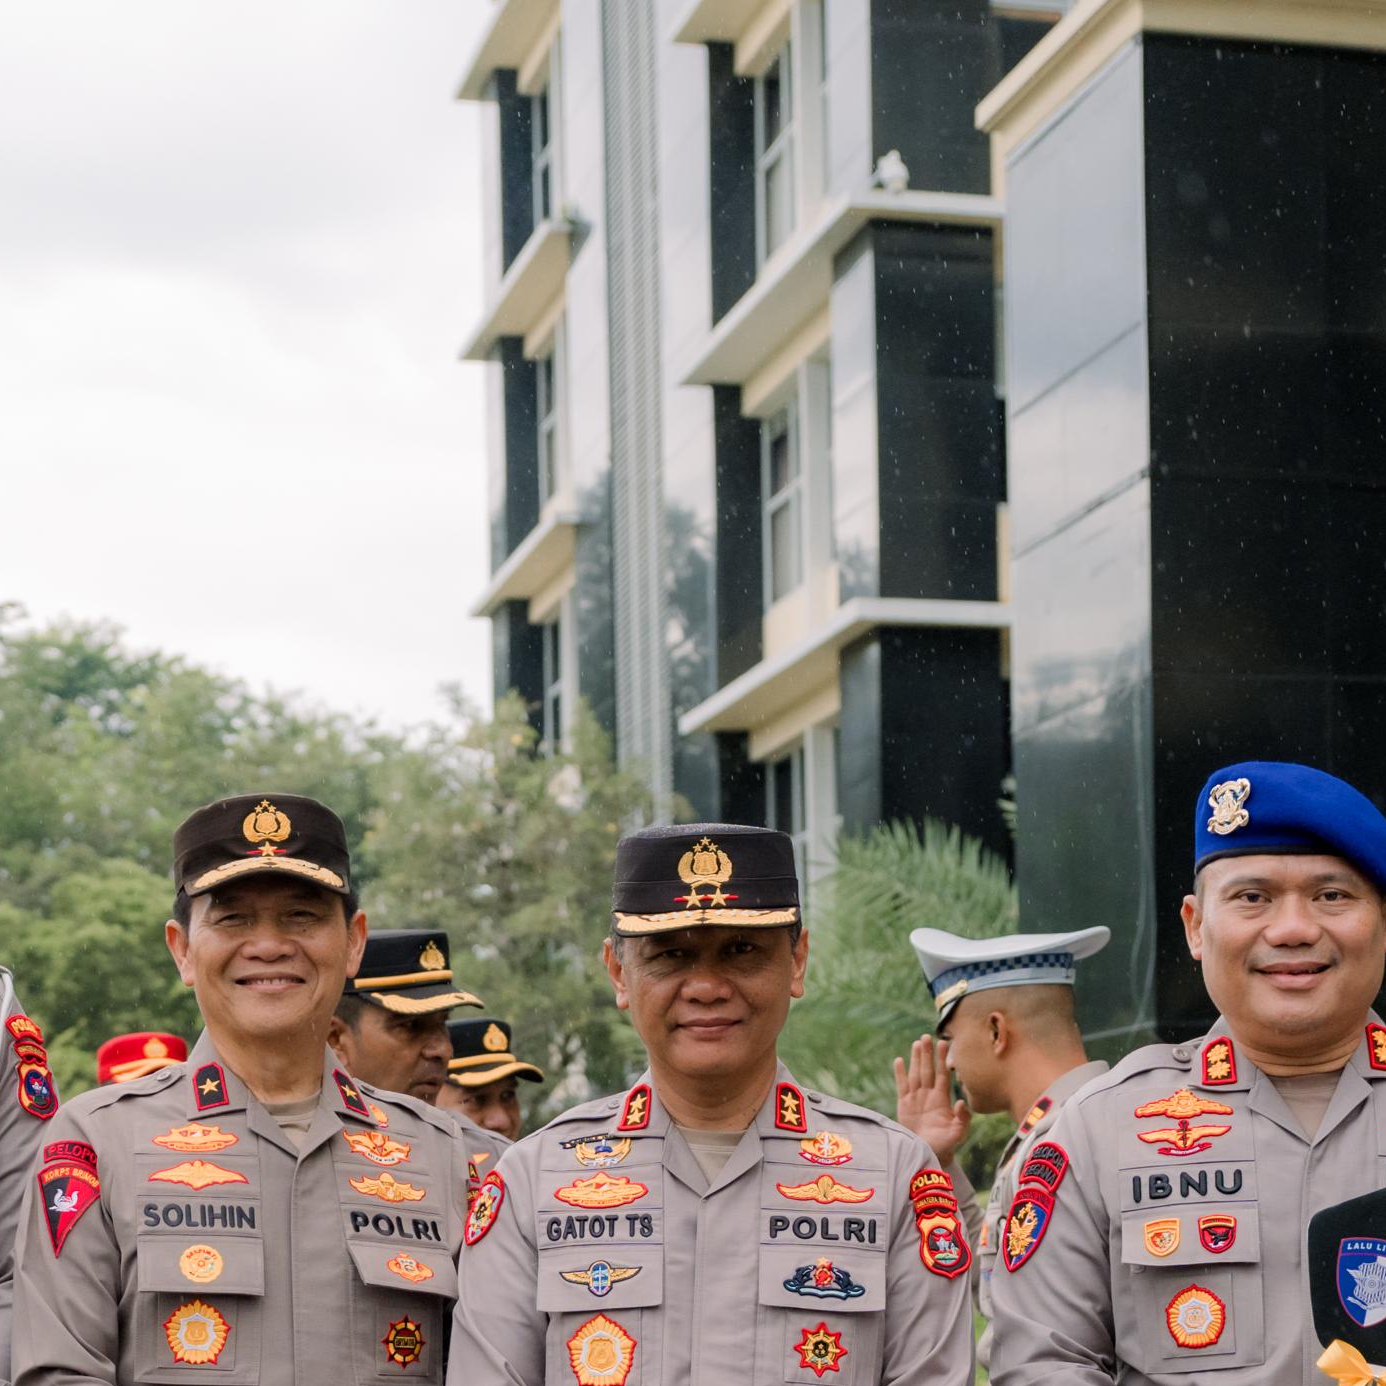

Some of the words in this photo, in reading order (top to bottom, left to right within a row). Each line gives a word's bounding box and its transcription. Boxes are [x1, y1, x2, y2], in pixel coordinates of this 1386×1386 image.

[912, 1173, 948, 1192] POLDA
[1131, 1168, 1244, 1203] IBNU
[143, 1203, 256, 1230] SOLIHIN
[349, 1211, 442, 1243] POLRI
[546, 1214, 619, 1242] GATOT
[625, 1213, 654, 1238] TS
[769, 1215, 877, 1244] POLRI
[1347, 1242, 1373, 1250] LALU
